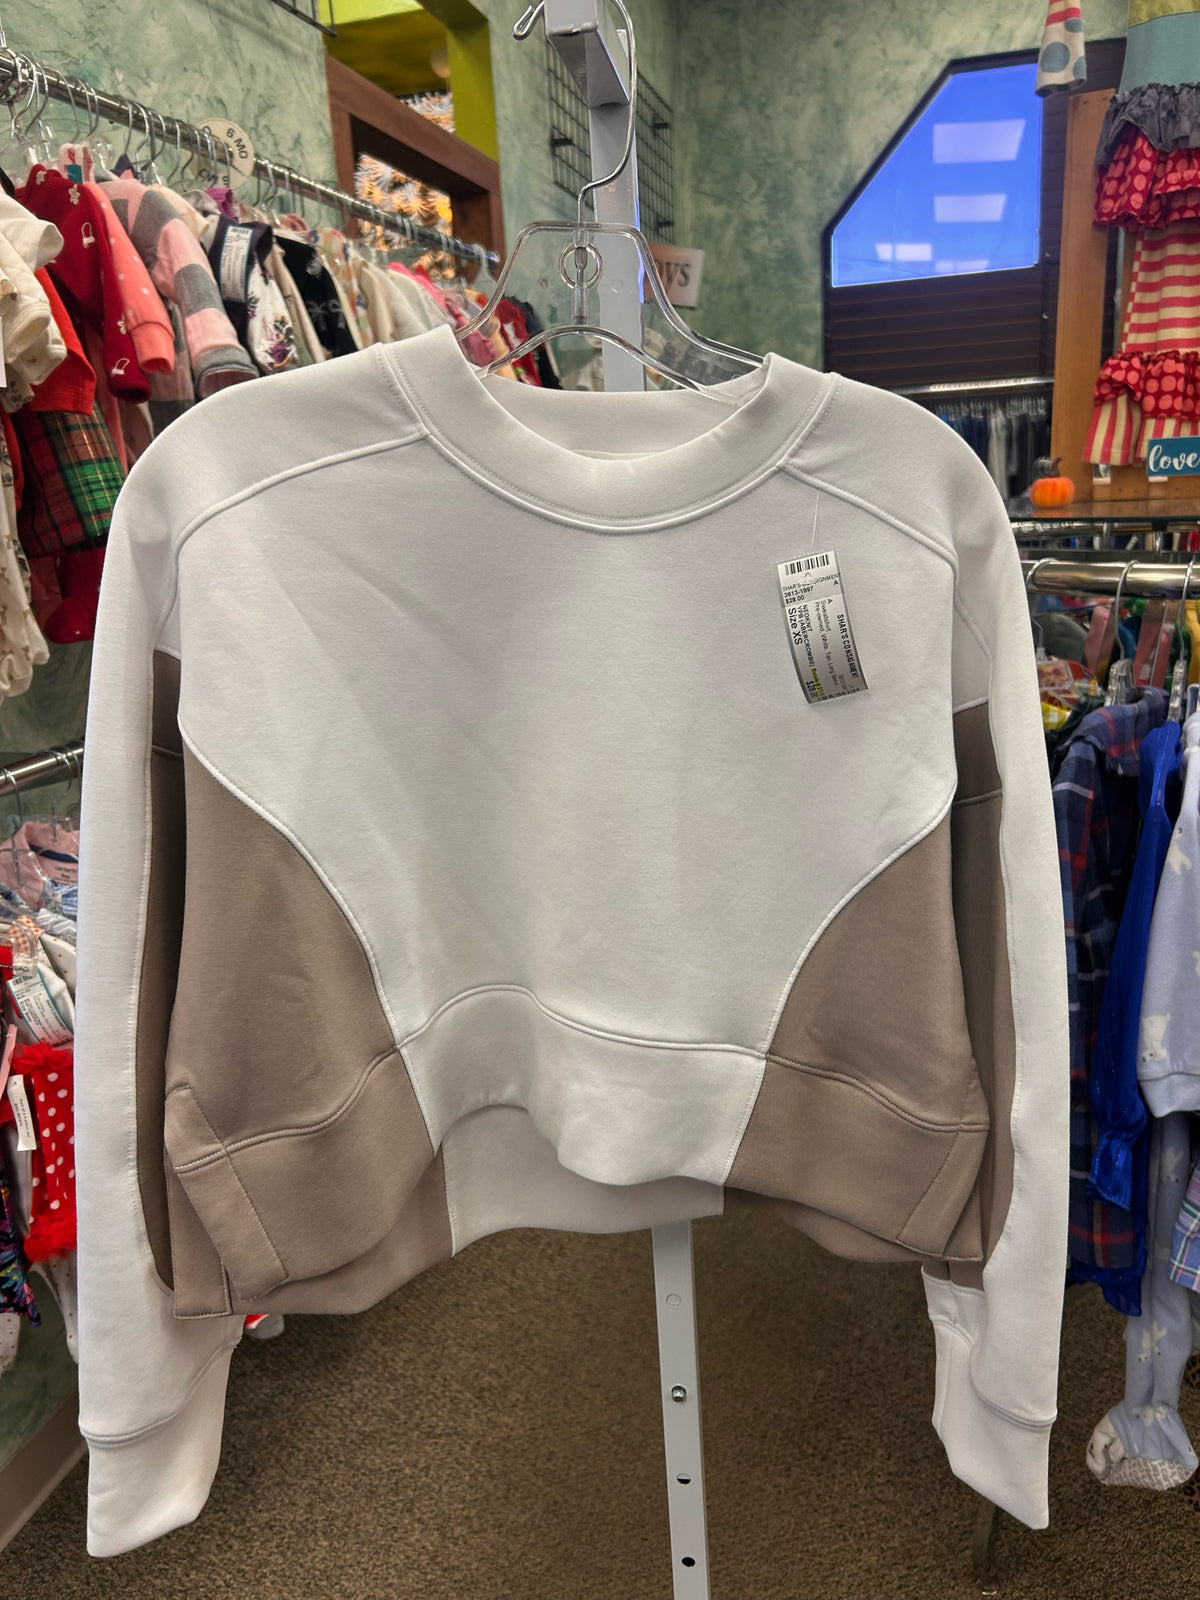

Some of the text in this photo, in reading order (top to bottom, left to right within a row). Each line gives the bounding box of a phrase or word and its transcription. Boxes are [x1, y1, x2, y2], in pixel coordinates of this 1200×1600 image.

[226, 128, 248, 159] 6 MO
[1148, 444, 1200, 473] love
[787, 607, 803, 646] Size XS
[802, 604, 813, 632] NEOKNIT
[820, 600, 832, 632] Sweatshirt
[836, 614, 849, 640] SHAR'S
